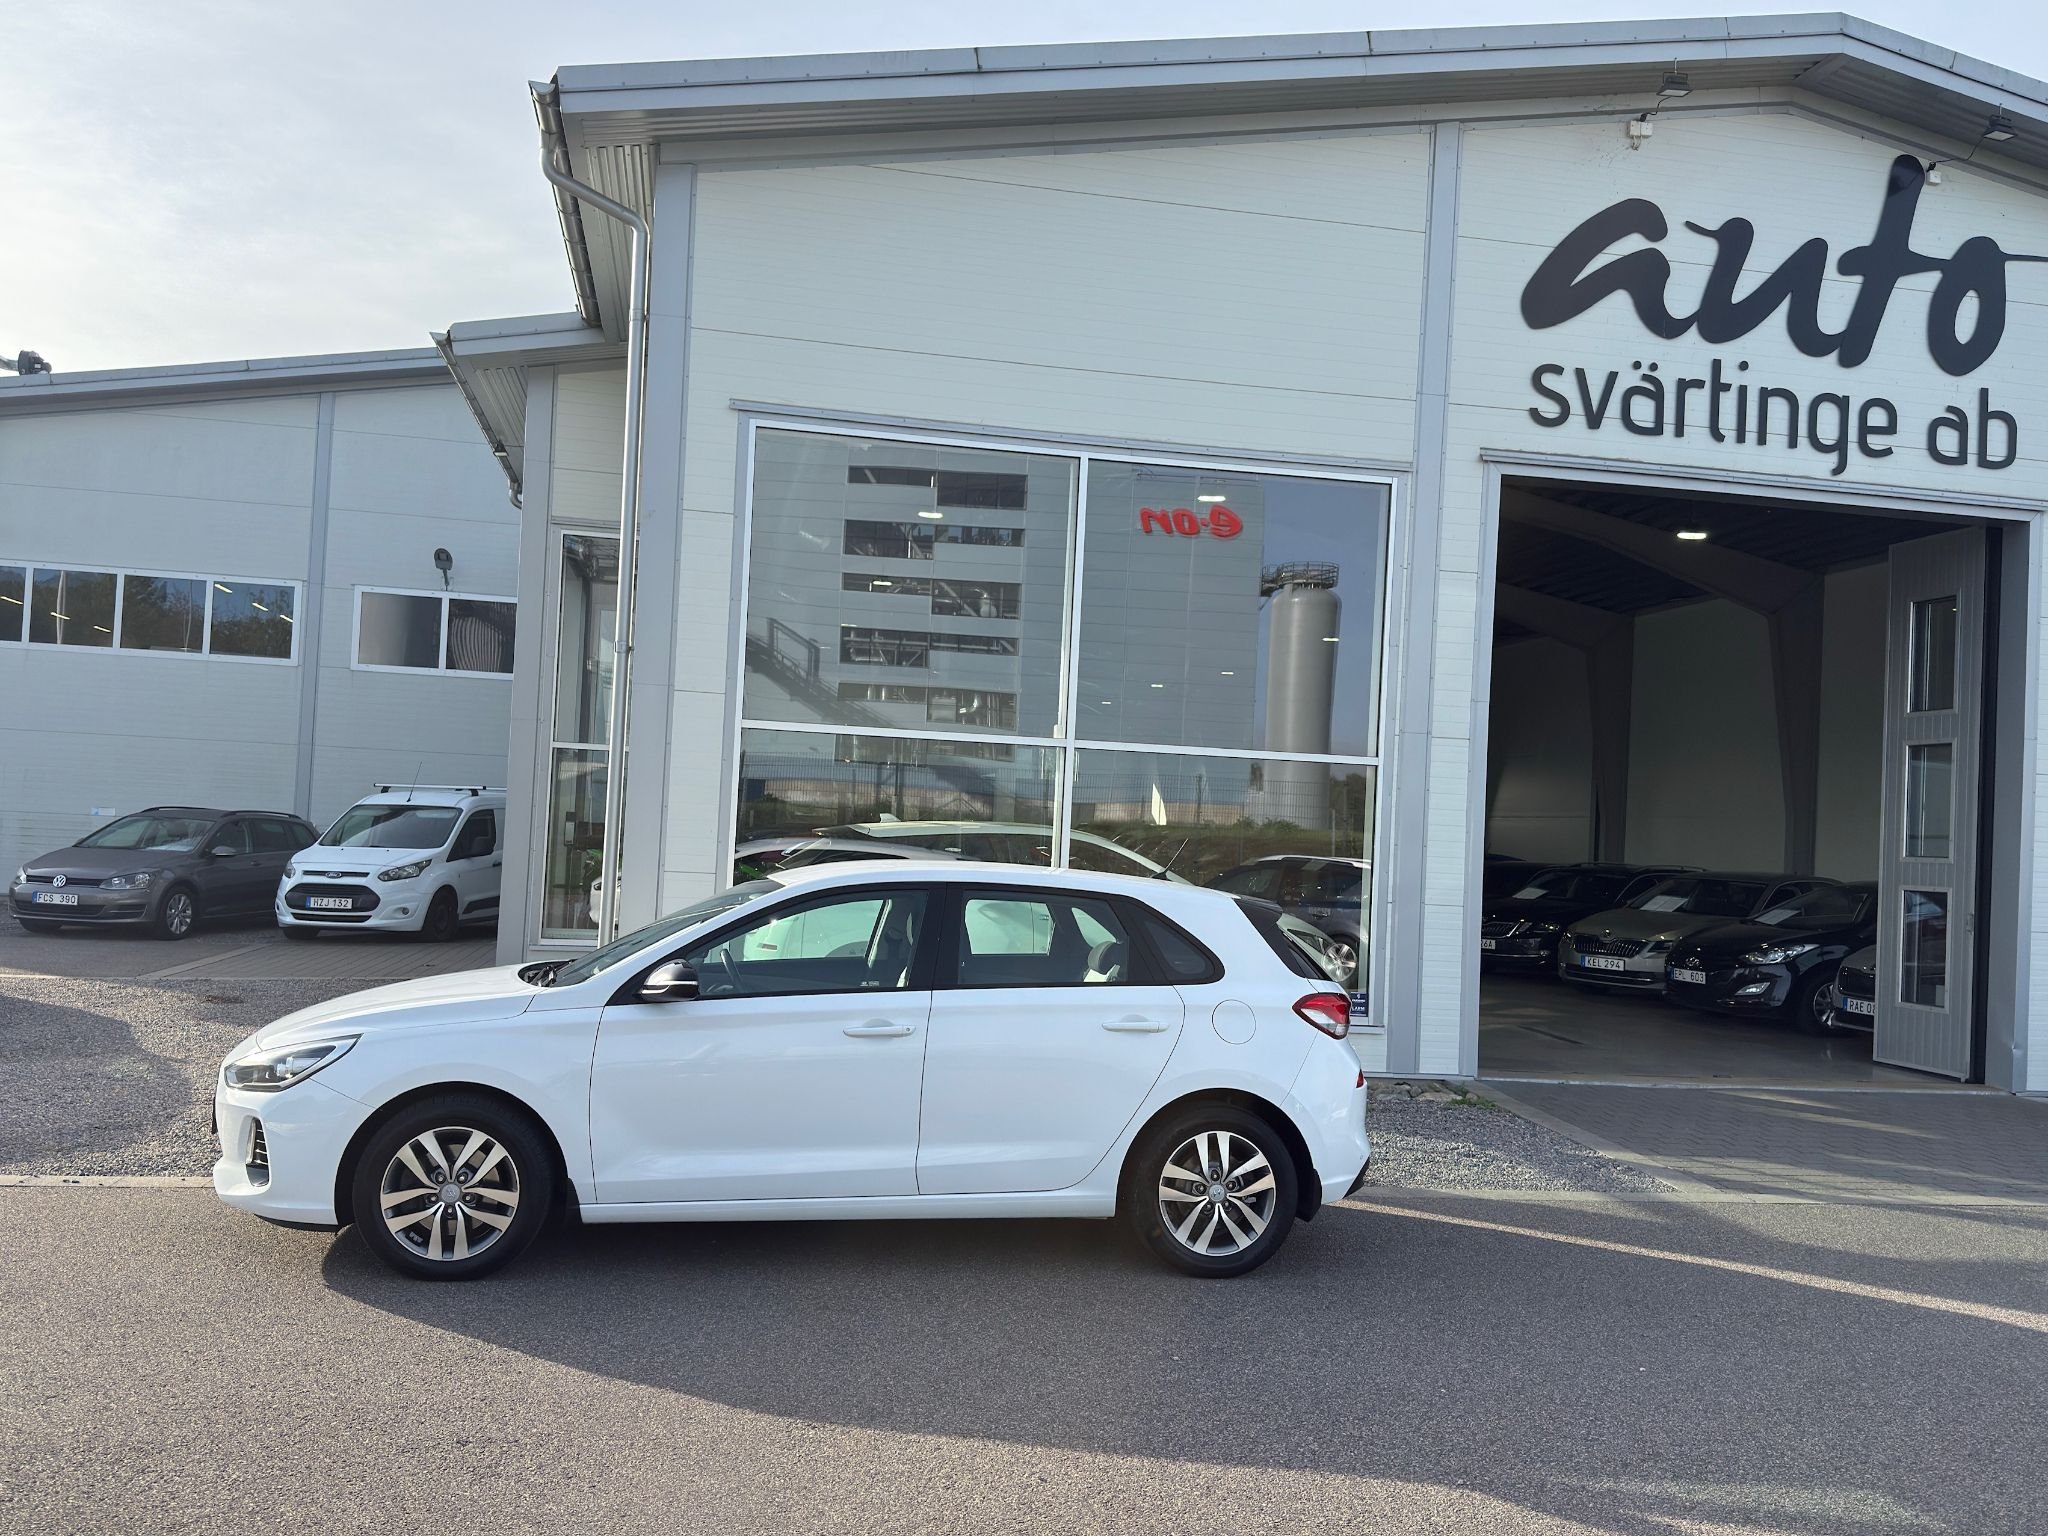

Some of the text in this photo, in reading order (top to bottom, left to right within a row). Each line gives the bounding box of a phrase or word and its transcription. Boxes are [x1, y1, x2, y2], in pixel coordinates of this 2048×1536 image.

[1521, 154, 2048, 376] auto
[1528, 358, 2018, 476] svärtinge ab
[38, 893, 77, 904] FCS 390
[313, 898, 349, 908] HZJ 132
[1587, 957, 1621, 969] KEL 294
[1691, 971, 1704, 983] 603
[1850, 1000, 1865, 1013] RAE
